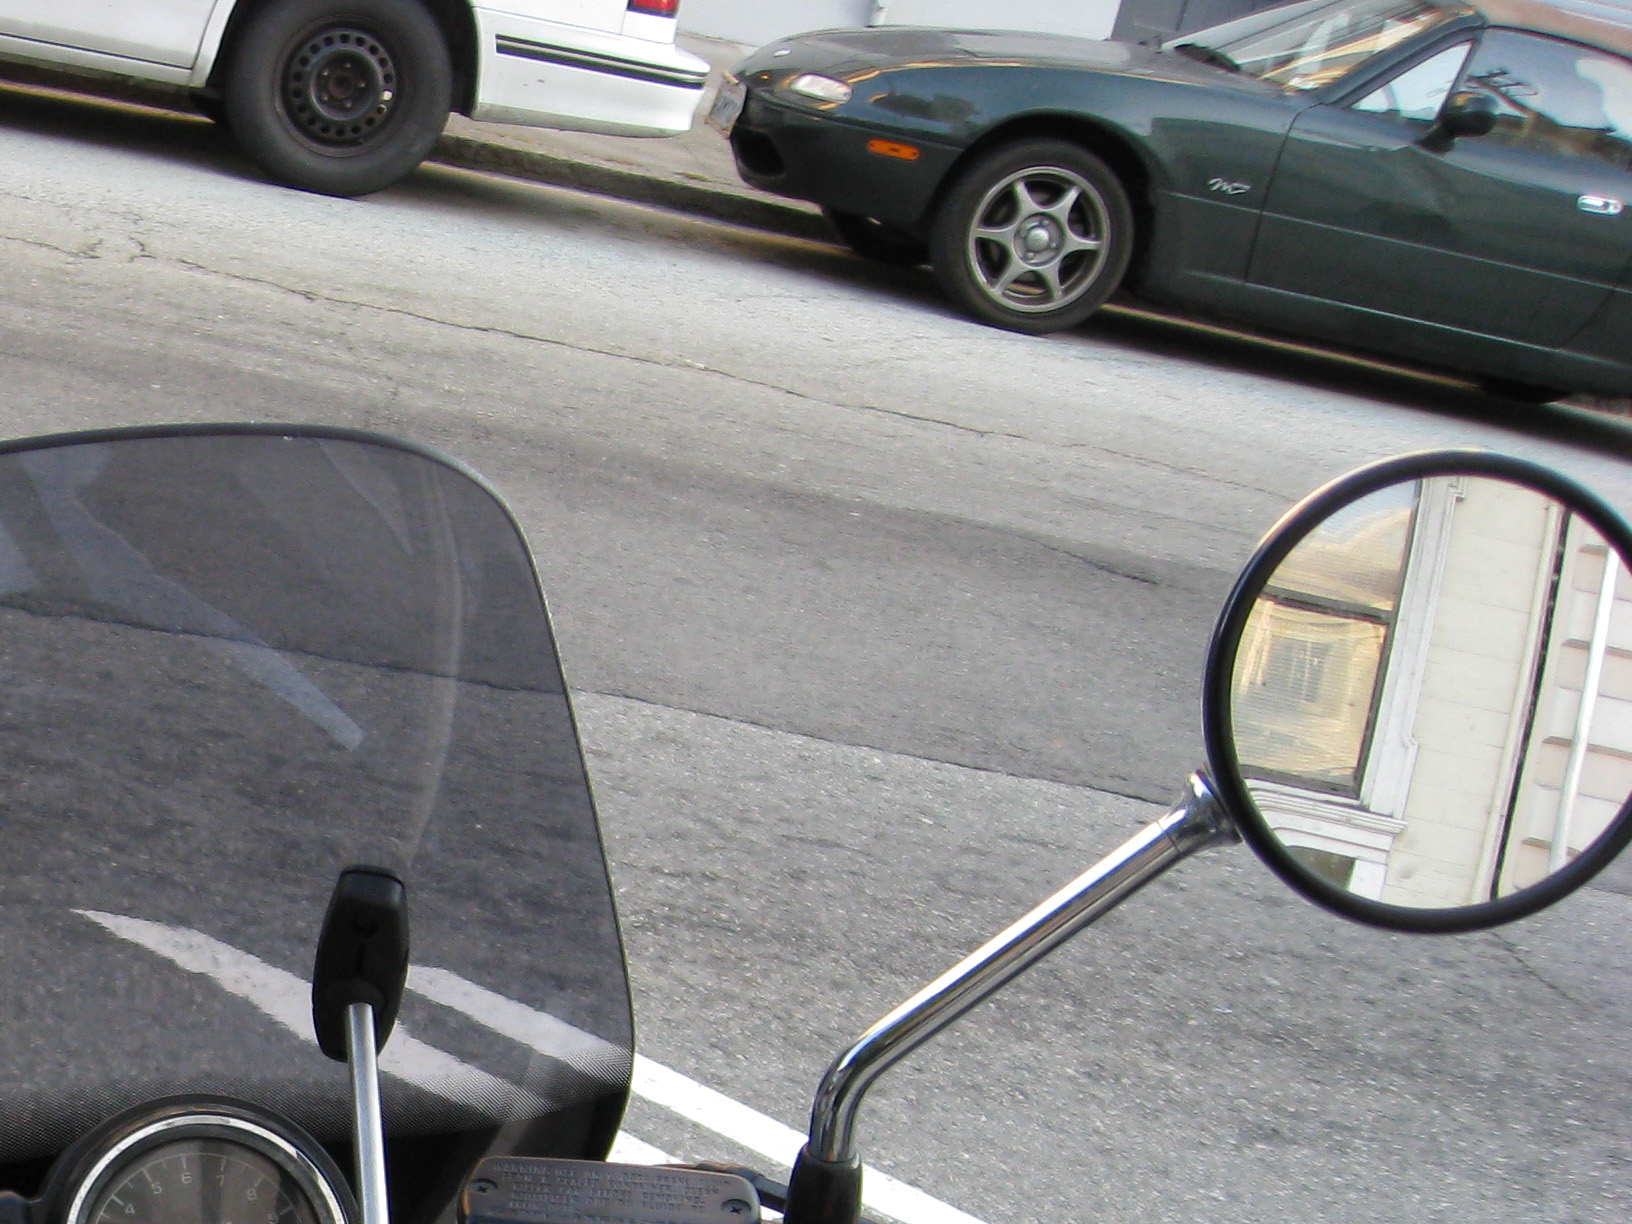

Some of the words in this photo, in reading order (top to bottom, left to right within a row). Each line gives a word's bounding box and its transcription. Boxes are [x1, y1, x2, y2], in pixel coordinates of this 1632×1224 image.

[181, 1172, 193, 1184] 6
[215, 1175, 225, 1187] 7
[152, 1182, 163, 1195] 5
[246, 1188, 258, 1201] 8
[124, 1203, 136, 1216] 4
[268, 1213, 279, 1224] 9
